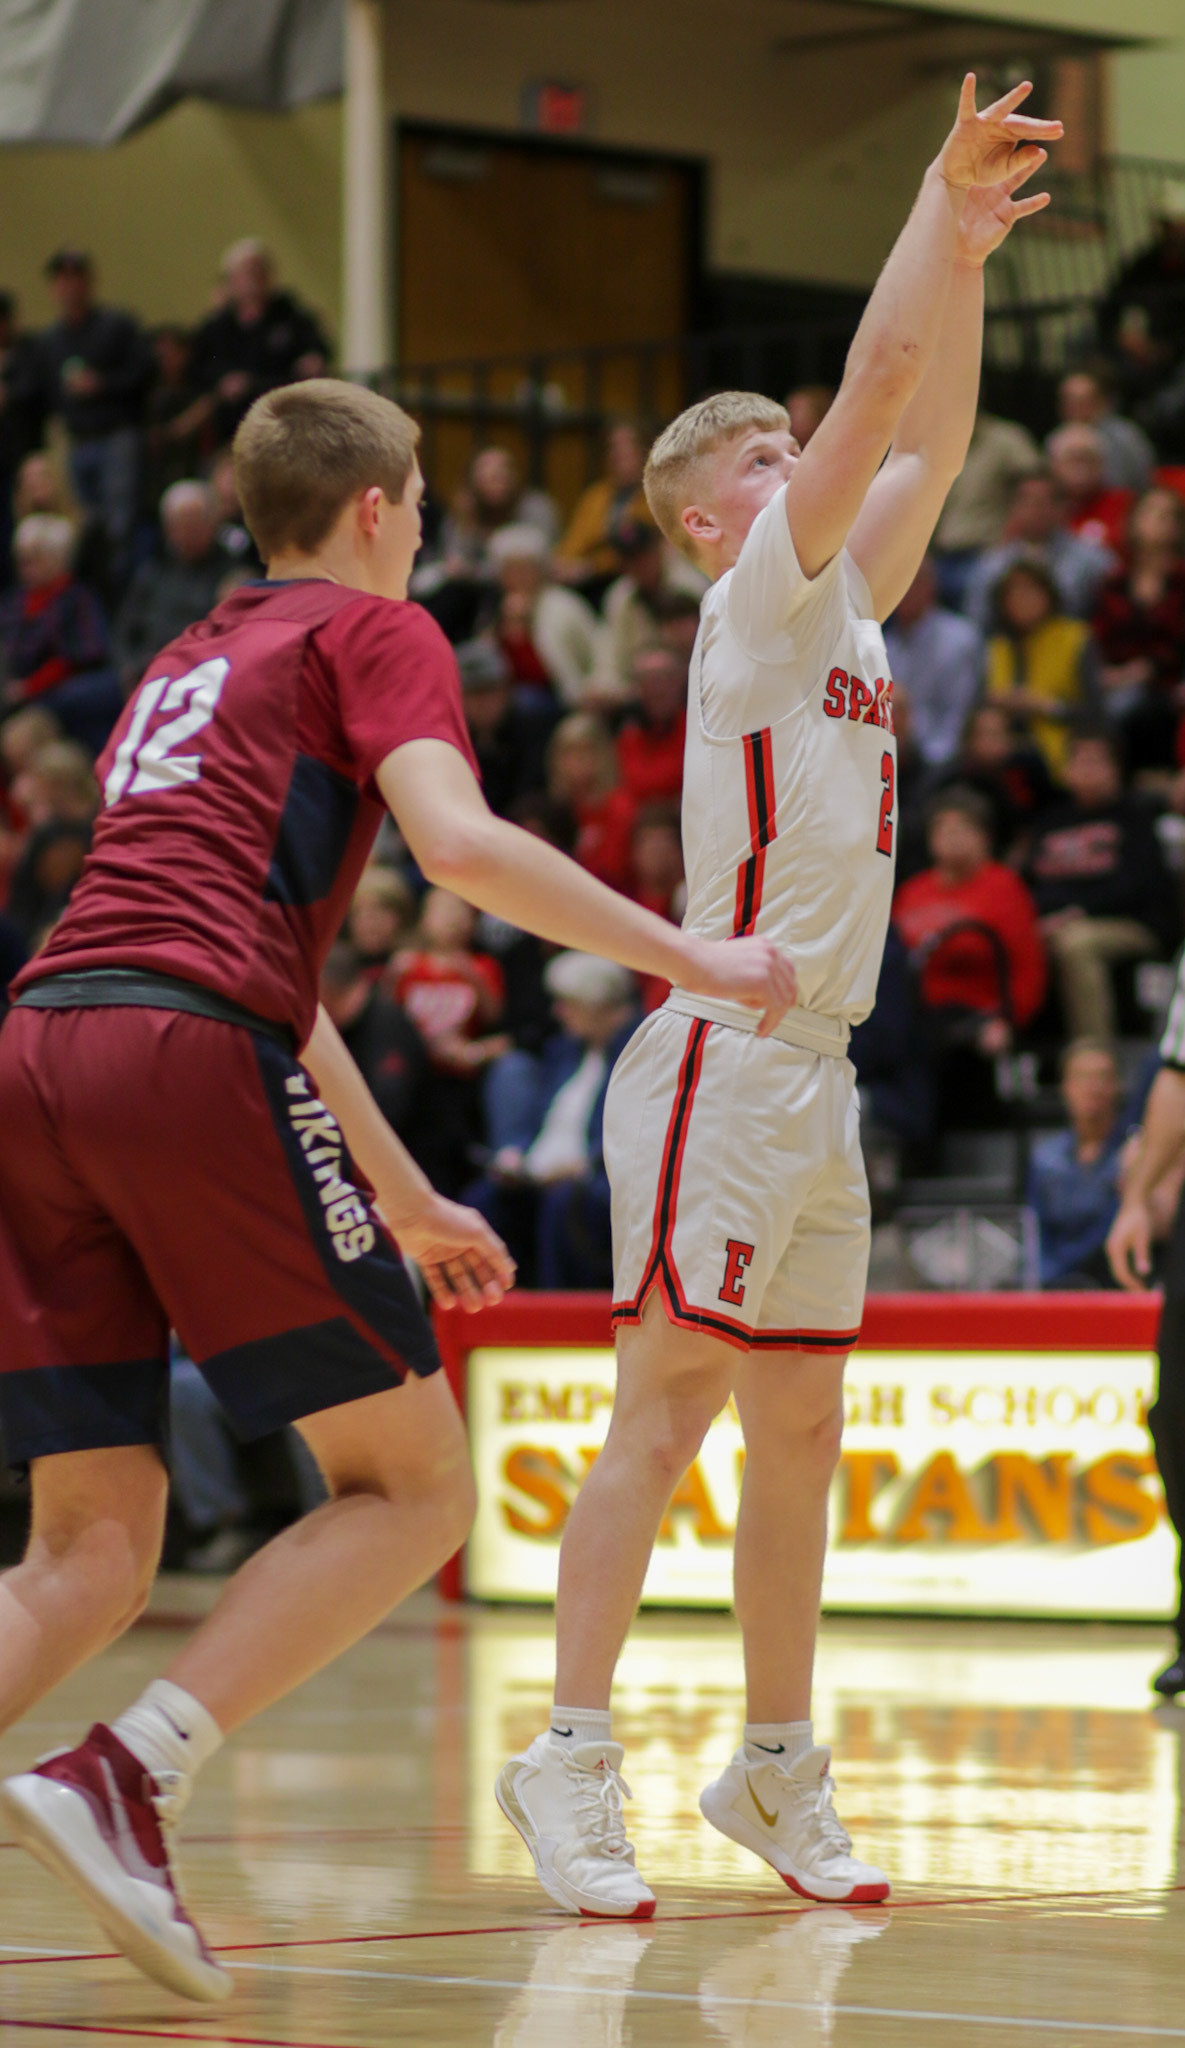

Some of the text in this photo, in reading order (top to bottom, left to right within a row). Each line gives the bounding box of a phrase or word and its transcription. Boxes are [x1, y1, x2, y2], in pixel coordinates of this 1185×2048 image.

[104, 656, 231, 809] 12
[876, 751, 894, 857] 2
[718, 1238, 755, 1307] E
